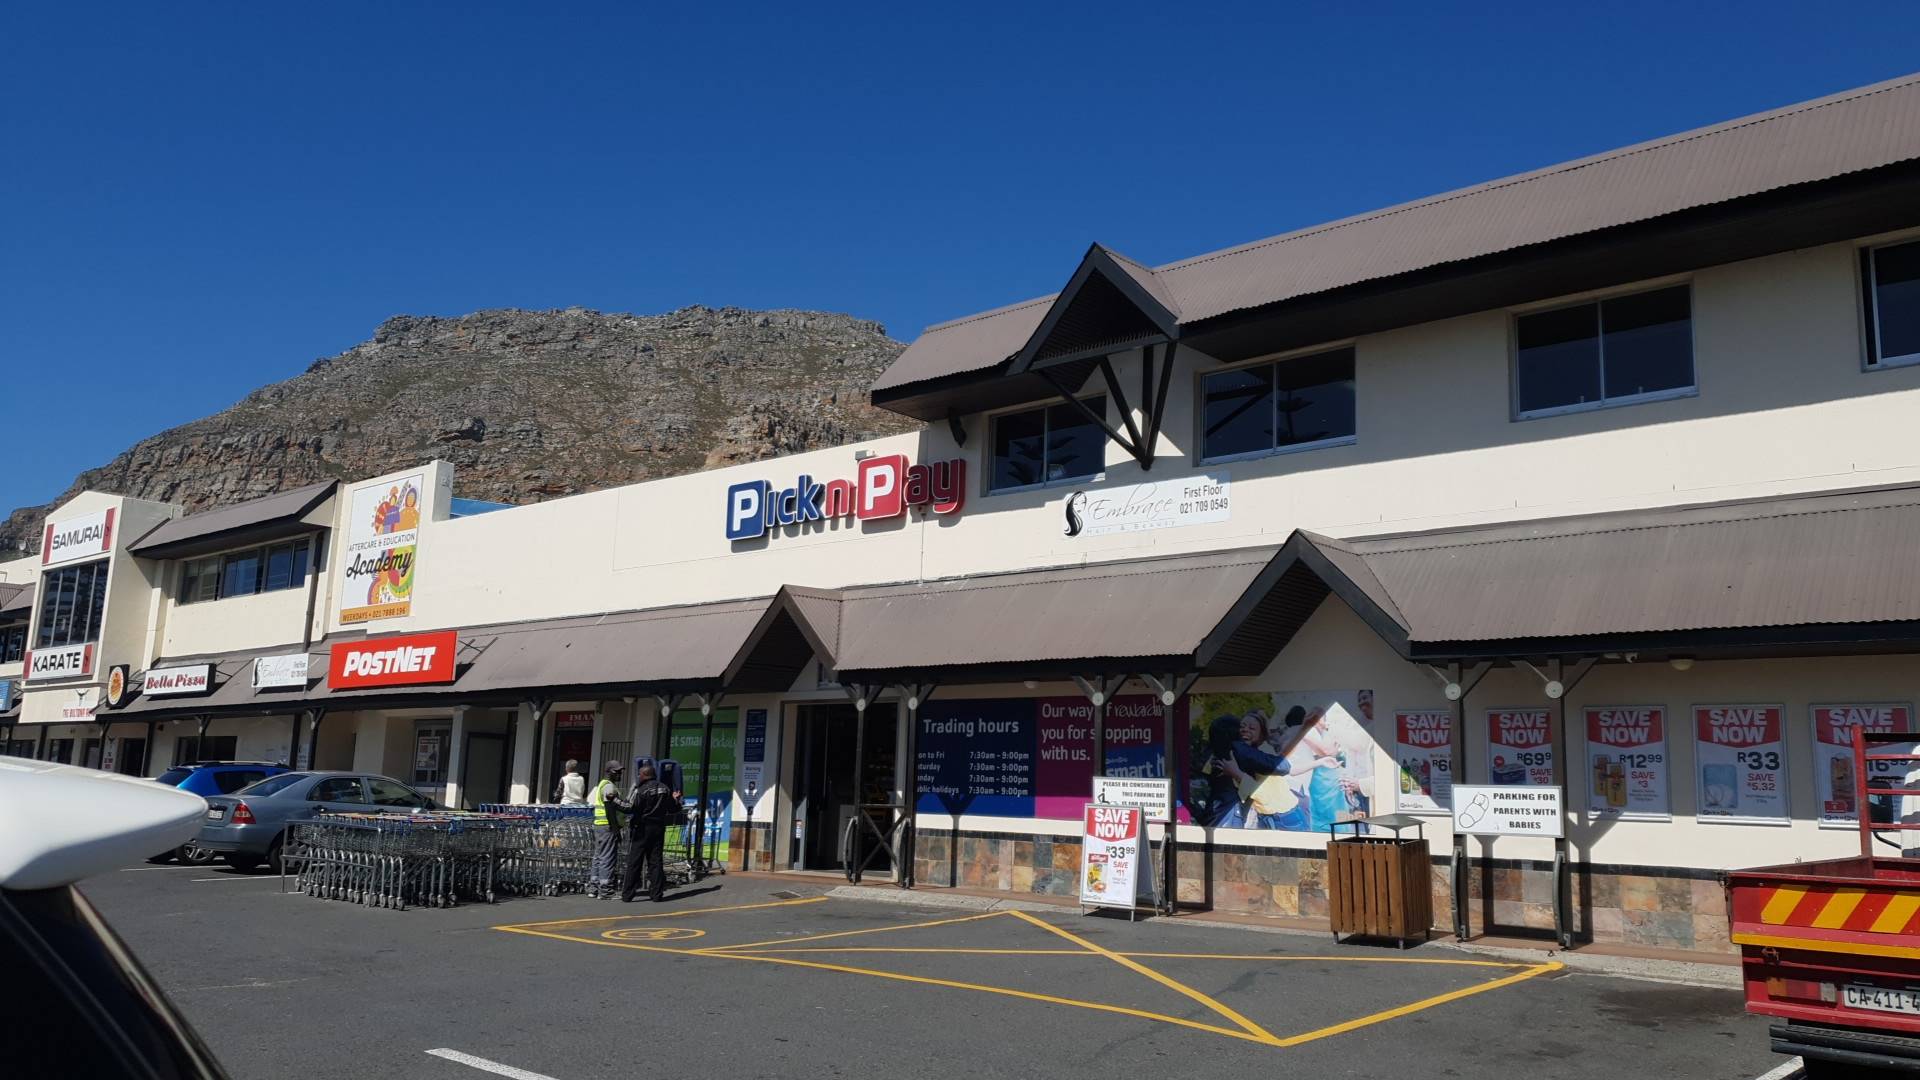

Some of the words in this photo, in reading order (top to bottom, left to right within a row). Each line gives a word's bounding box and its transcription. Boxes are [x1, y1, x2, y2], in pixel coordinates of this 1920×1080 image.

[726, 475, 820, 539] Pick
[825, 479, 852, 518] n
[857, 454, 966, 520] Pay
[1184, 487, 1202, 498] First
[1203, 485, 1223, 497] Floor
[1180, 503, 1193, 514] 021
[1195, 500, 1208, 512] 709
[1210, 498, 1229, 510] 0549
[52, 523, 104, 550] SAMURAI
[349, 540, 376, 552] AFTERCARE
[383, 533, 416, 547] EDUCATION
[346, 551, 413, 580] Academy
[342, 611, 368, 622] WEEKDAYS
[32, 651, 81, 673] KARATE
[146, 673, 174, 690] Bella
[174, 673, 206, 688] Pizza
[1042, 703, 1066, 718] Our
[1068, 705, 1094, 721] way
[1600, 710, 1651, 726] SAVE
[1709, 709, 1767, 726] SAVE
[1829, 708, 1894, 726] SAVE
[923, 718, 974, 737] Trading
[978, 718, 1020, 733] hours
[1406, 713, 1450, 729] SAVE
[1500, 713, 1547, 728] SAVE
[1042, 728, 1064, 744] you
[1067, 724, 1086, 739] for
[1090, 725, 1152, 744] sopping
[1408, 729, 1449, 744] NOW
[1501, 729, 1545, 744] NOW
[1602, 727, 1650, 743] NOW
[1712, 727, 1766, 743] NOW
[936, 751, 945, 759] Fri
[969, 751, 995, 759] 7:30am
[1002, 751, 1029, 761] 9:00pm
[1042, 745, 1068, 761] with
[1072, 748, 1091, 761] us.
[1737, 751, 1780, 771] R33
[969, 763, 995, 771] 7:30am
[1001, 763, 1029, 773] 9:00pm
[1106, 760, 1153, 777] smart
[1530, 768, 1552, 776] SAVE
[1631, 771, 1655, 780] SAVE
[968, 775, 995, 783] 7:30am
[1001, 775, 1029, 785] 9:00pm
[1748, 773, 1775, 782] SAVE
[932, 785, 959, 796] holidays
[968, 786, 995, 795] 7:30am
[1001, 787, 1029, 797] 9:00pm
[1493, 793, 1535, 801] PARKING
[1537, 793, 1556, 801] FOR
[1095, 808, 1131, 824] SAVE
[1493, 808, 1531, 816] PARENTS
[1533, 808, 1557, 816] WITH
[1095, 823, 1128, 839] NOW
[1509, 821, 1542, 829] BABIES
[1113, 861, 1129, 869] SAVE
